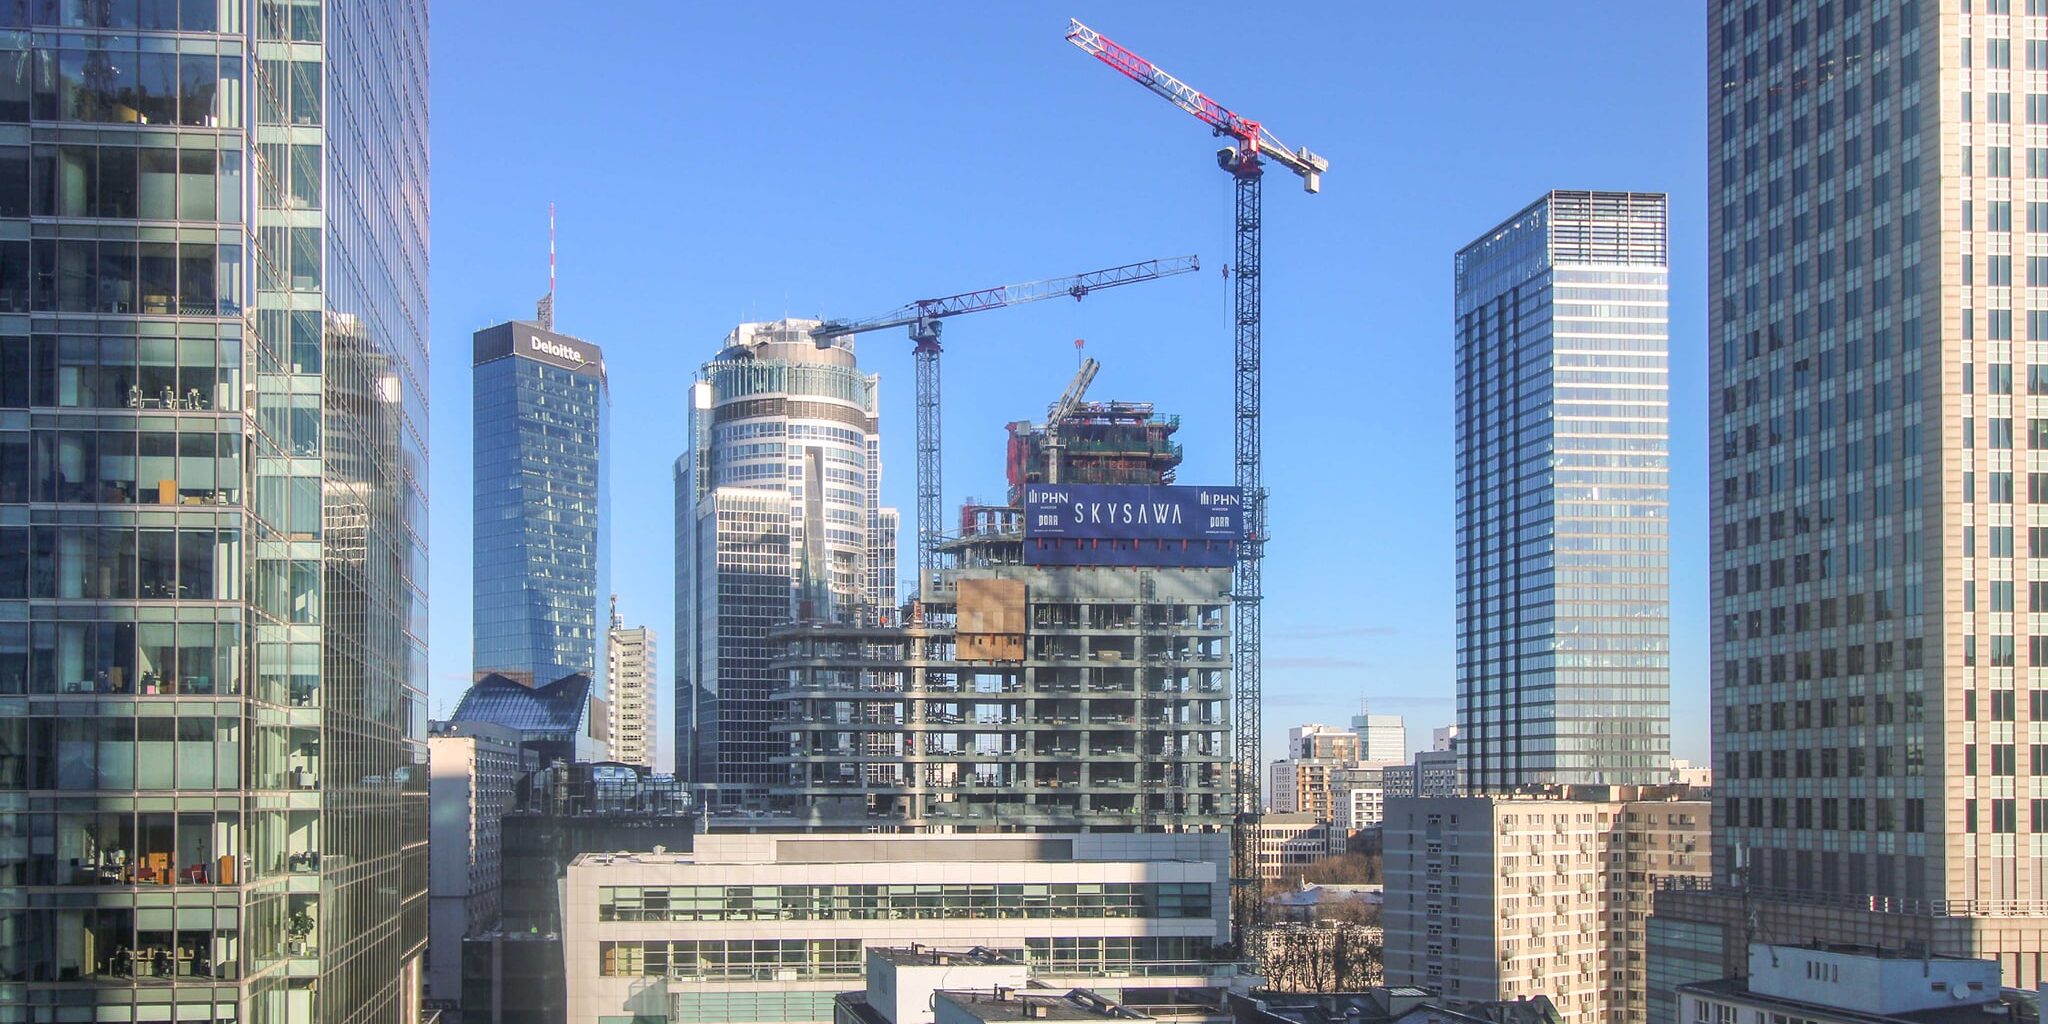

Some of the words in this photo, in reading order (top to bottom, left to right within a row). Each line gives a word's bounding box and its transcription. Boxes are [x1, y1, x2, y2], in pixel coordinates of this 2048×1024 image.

[1041, 492, 1069, 504] PHN
[1213, 494, 1240, 505] PHN
[1074, 503, 1182, 524] SKYSAWA
